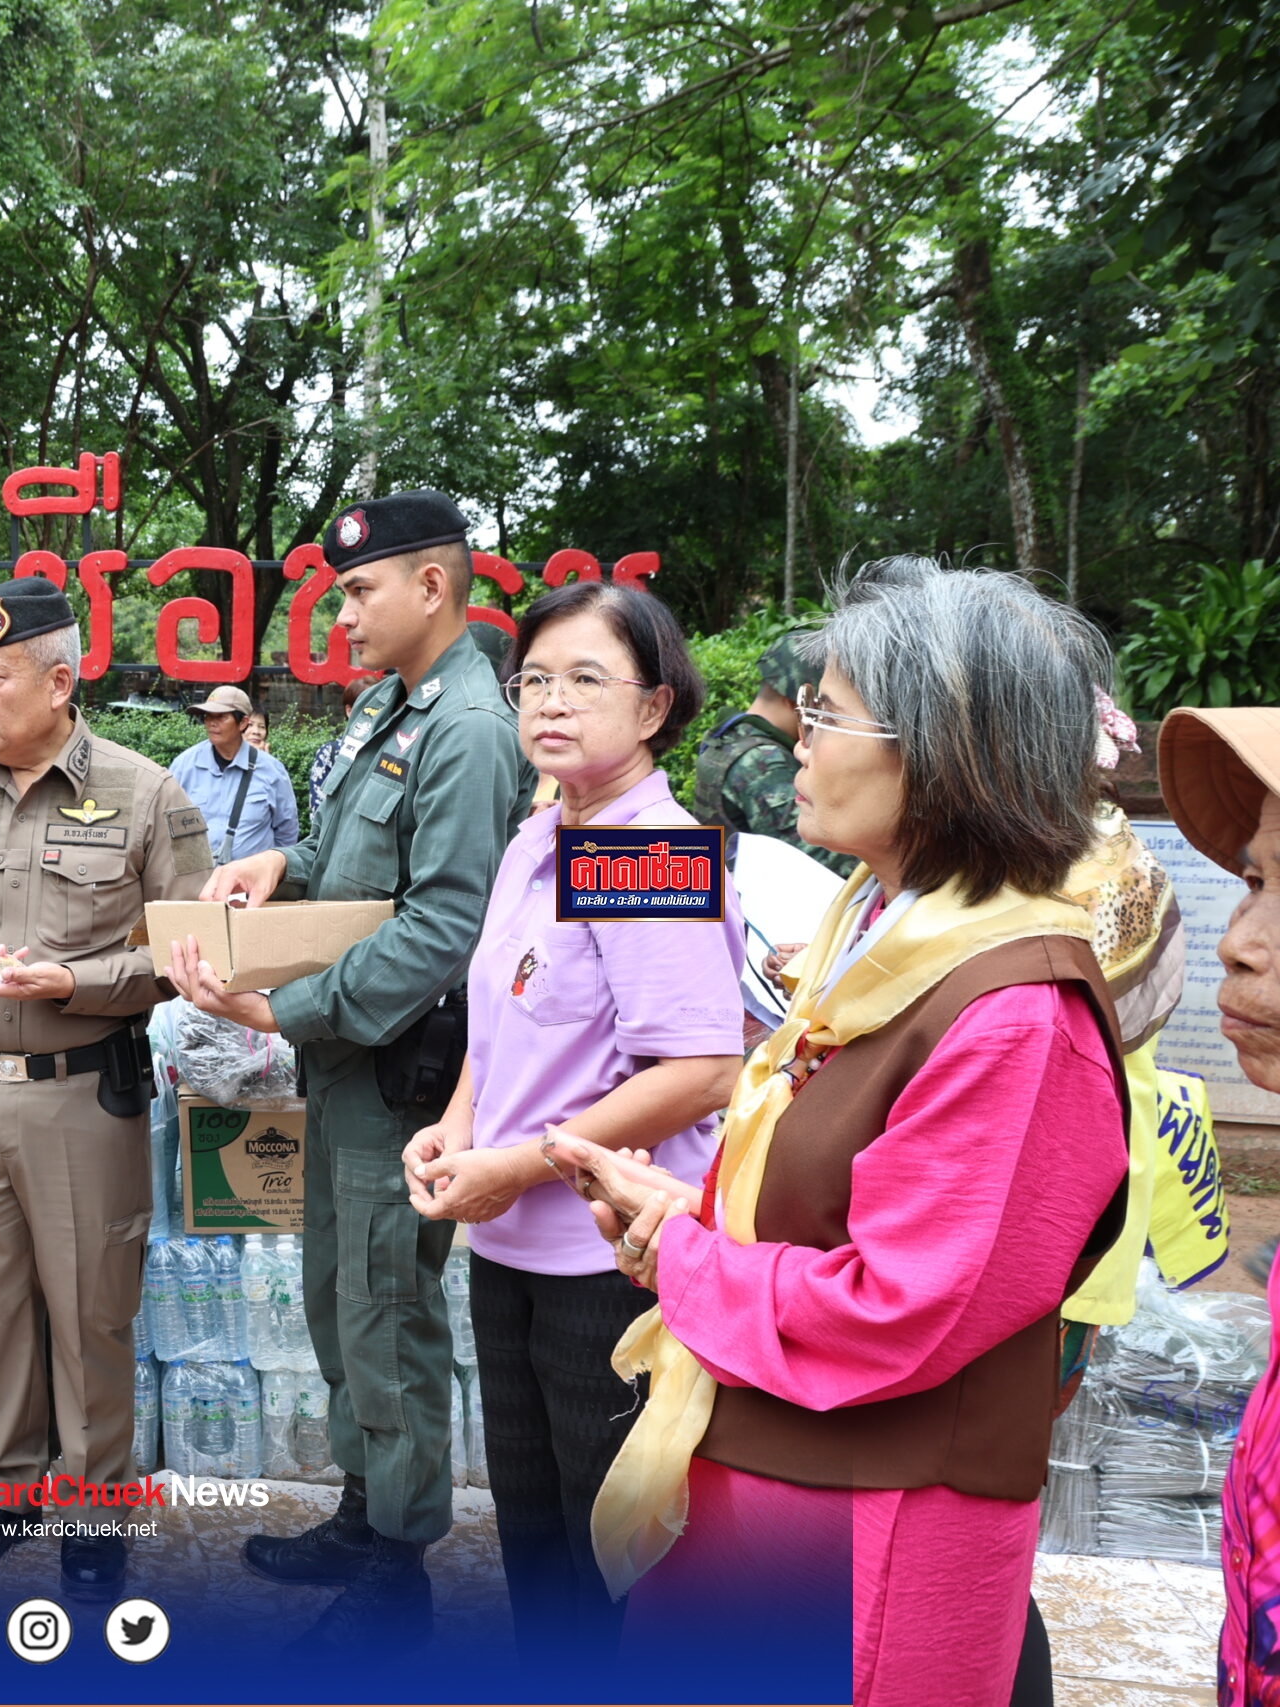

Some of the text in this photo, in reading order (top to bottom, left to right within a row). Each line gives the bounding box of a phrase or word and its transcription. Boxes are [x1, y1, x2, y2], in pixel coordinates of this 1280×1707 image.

[197, 1112, 243, 1129] 100
[248, 1141, 296, 1153] MOCCONA
[257, 1171, 293, 1191] Trio
